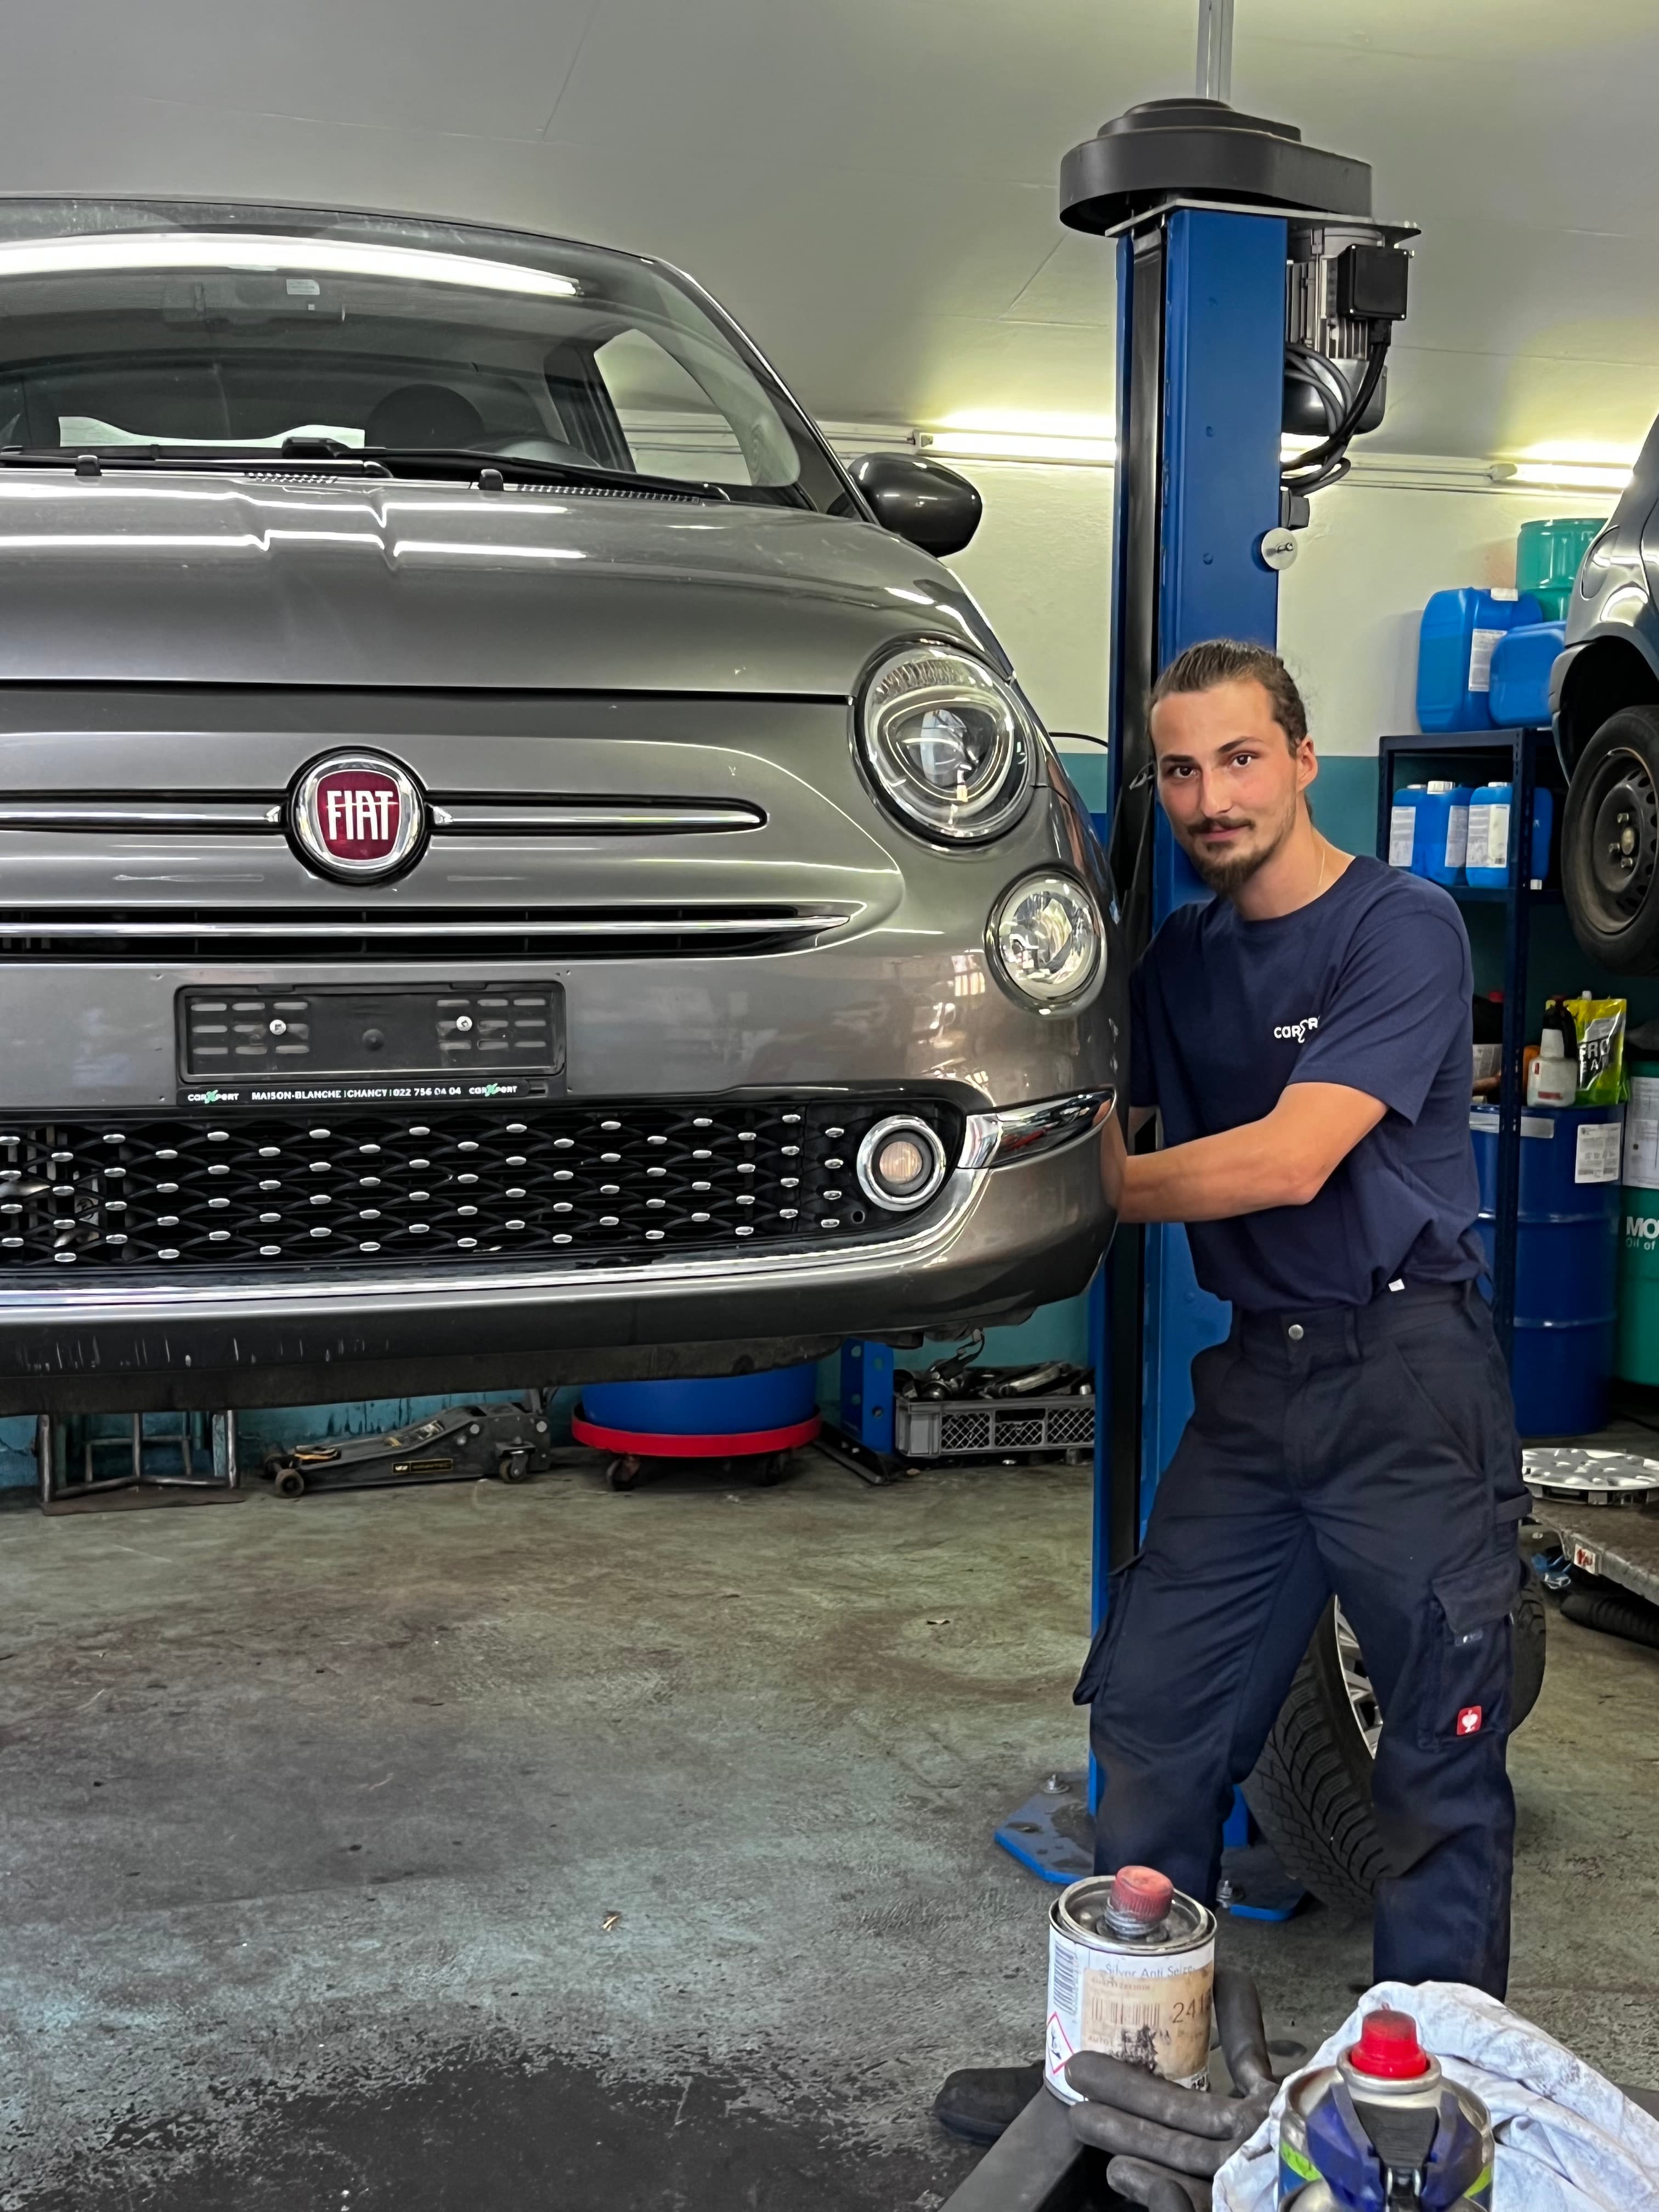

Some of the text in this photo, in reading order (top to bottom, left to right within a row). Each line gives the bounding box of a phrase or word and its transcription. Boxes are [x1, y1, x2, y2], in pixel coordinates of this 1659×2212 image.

[326, 790, 394, 840] FIAT
[251, 1090, 342, 1101] MAISON-BLANCHE
[347, 1088, 387, 1098] CHANCY
[393, 1088, 411, 1097] 022
[414, 1087, 432, 1096] 756
[434, 1087, 447, 1095] 04
[449, 1087, 461, 1095] 04
[1626, 1216, 1659, 1239] MO
